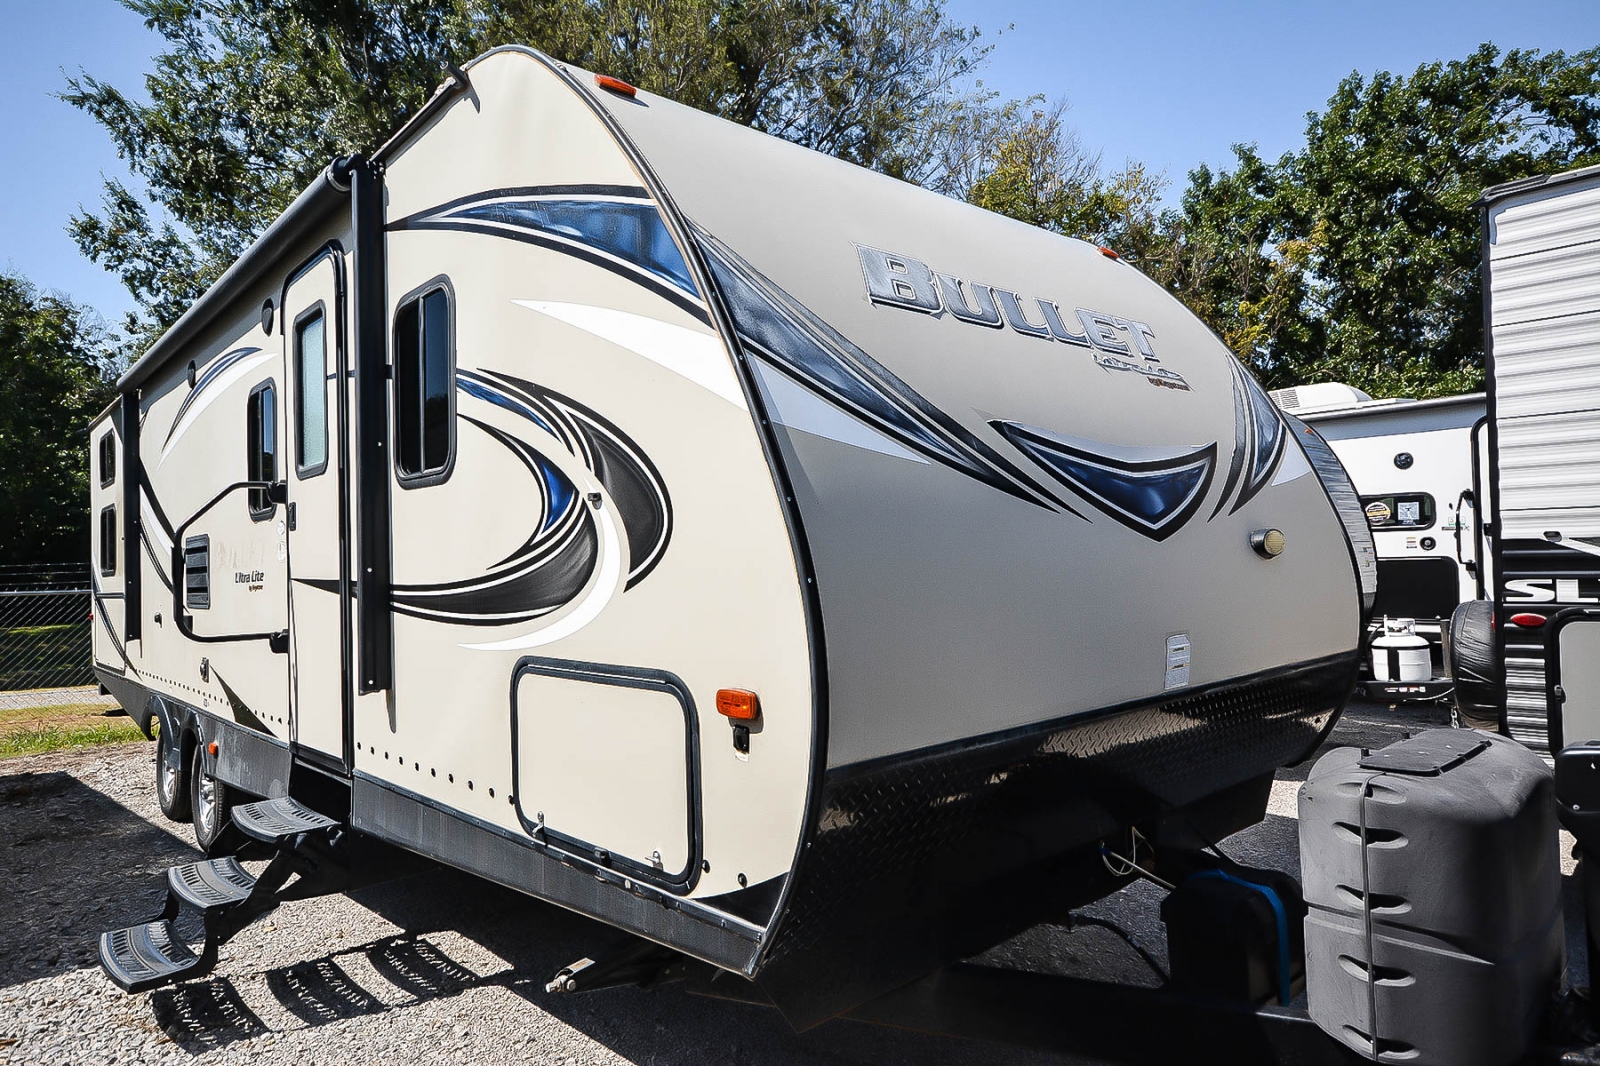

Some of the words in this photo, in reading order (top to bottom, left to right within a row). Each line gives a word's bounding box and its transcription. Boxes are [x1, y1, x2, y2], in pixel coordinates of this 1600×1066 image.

[855, 243, 1160, 362] BULLET
[235, 572, 250, 583] Ultra
[251, 570, 264, 582] Lite
[1504, 578, 1600, 603] SL
